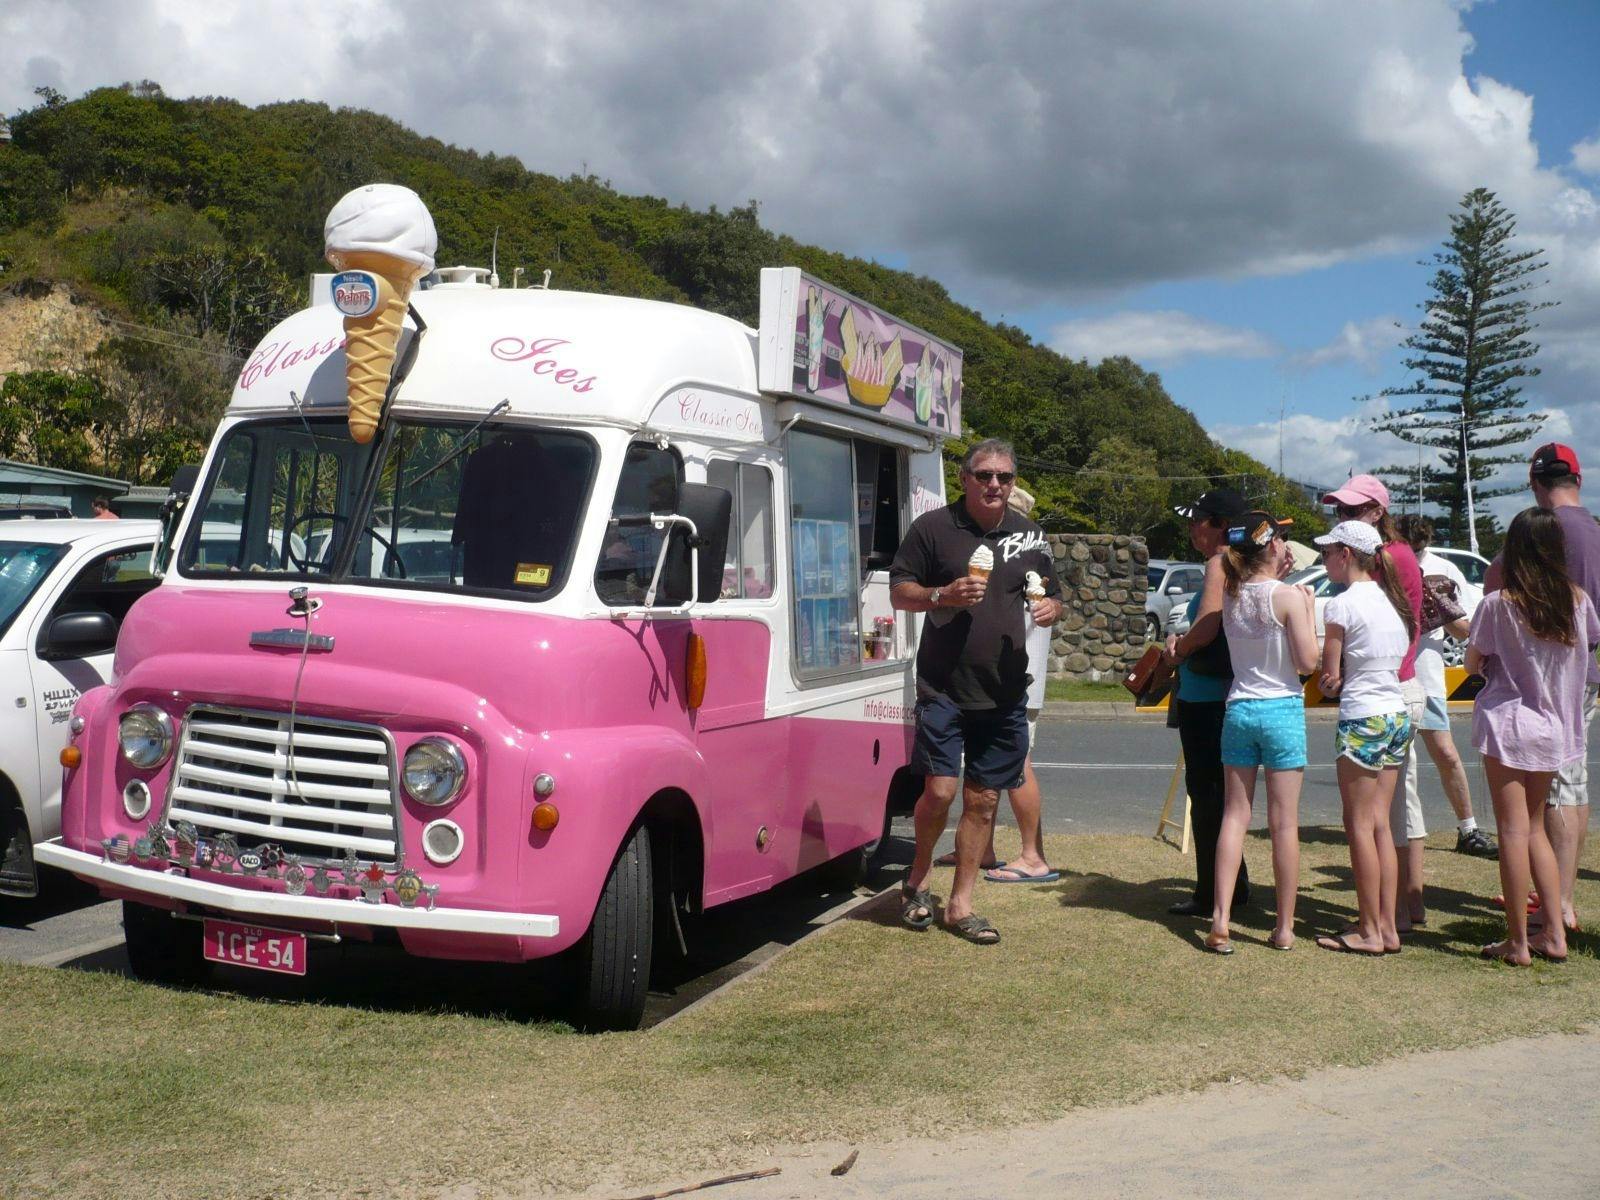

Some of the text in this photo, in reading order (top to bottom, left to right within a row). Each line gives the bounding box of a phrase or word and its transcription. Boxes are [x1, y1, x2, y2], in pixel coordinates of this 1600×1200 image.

[240, 337, 347, 391] Class
[490, 337, 597, 393] Ices
[678, 390, 731, 428] Classic
[43, 688, 79, 701] HILUX
